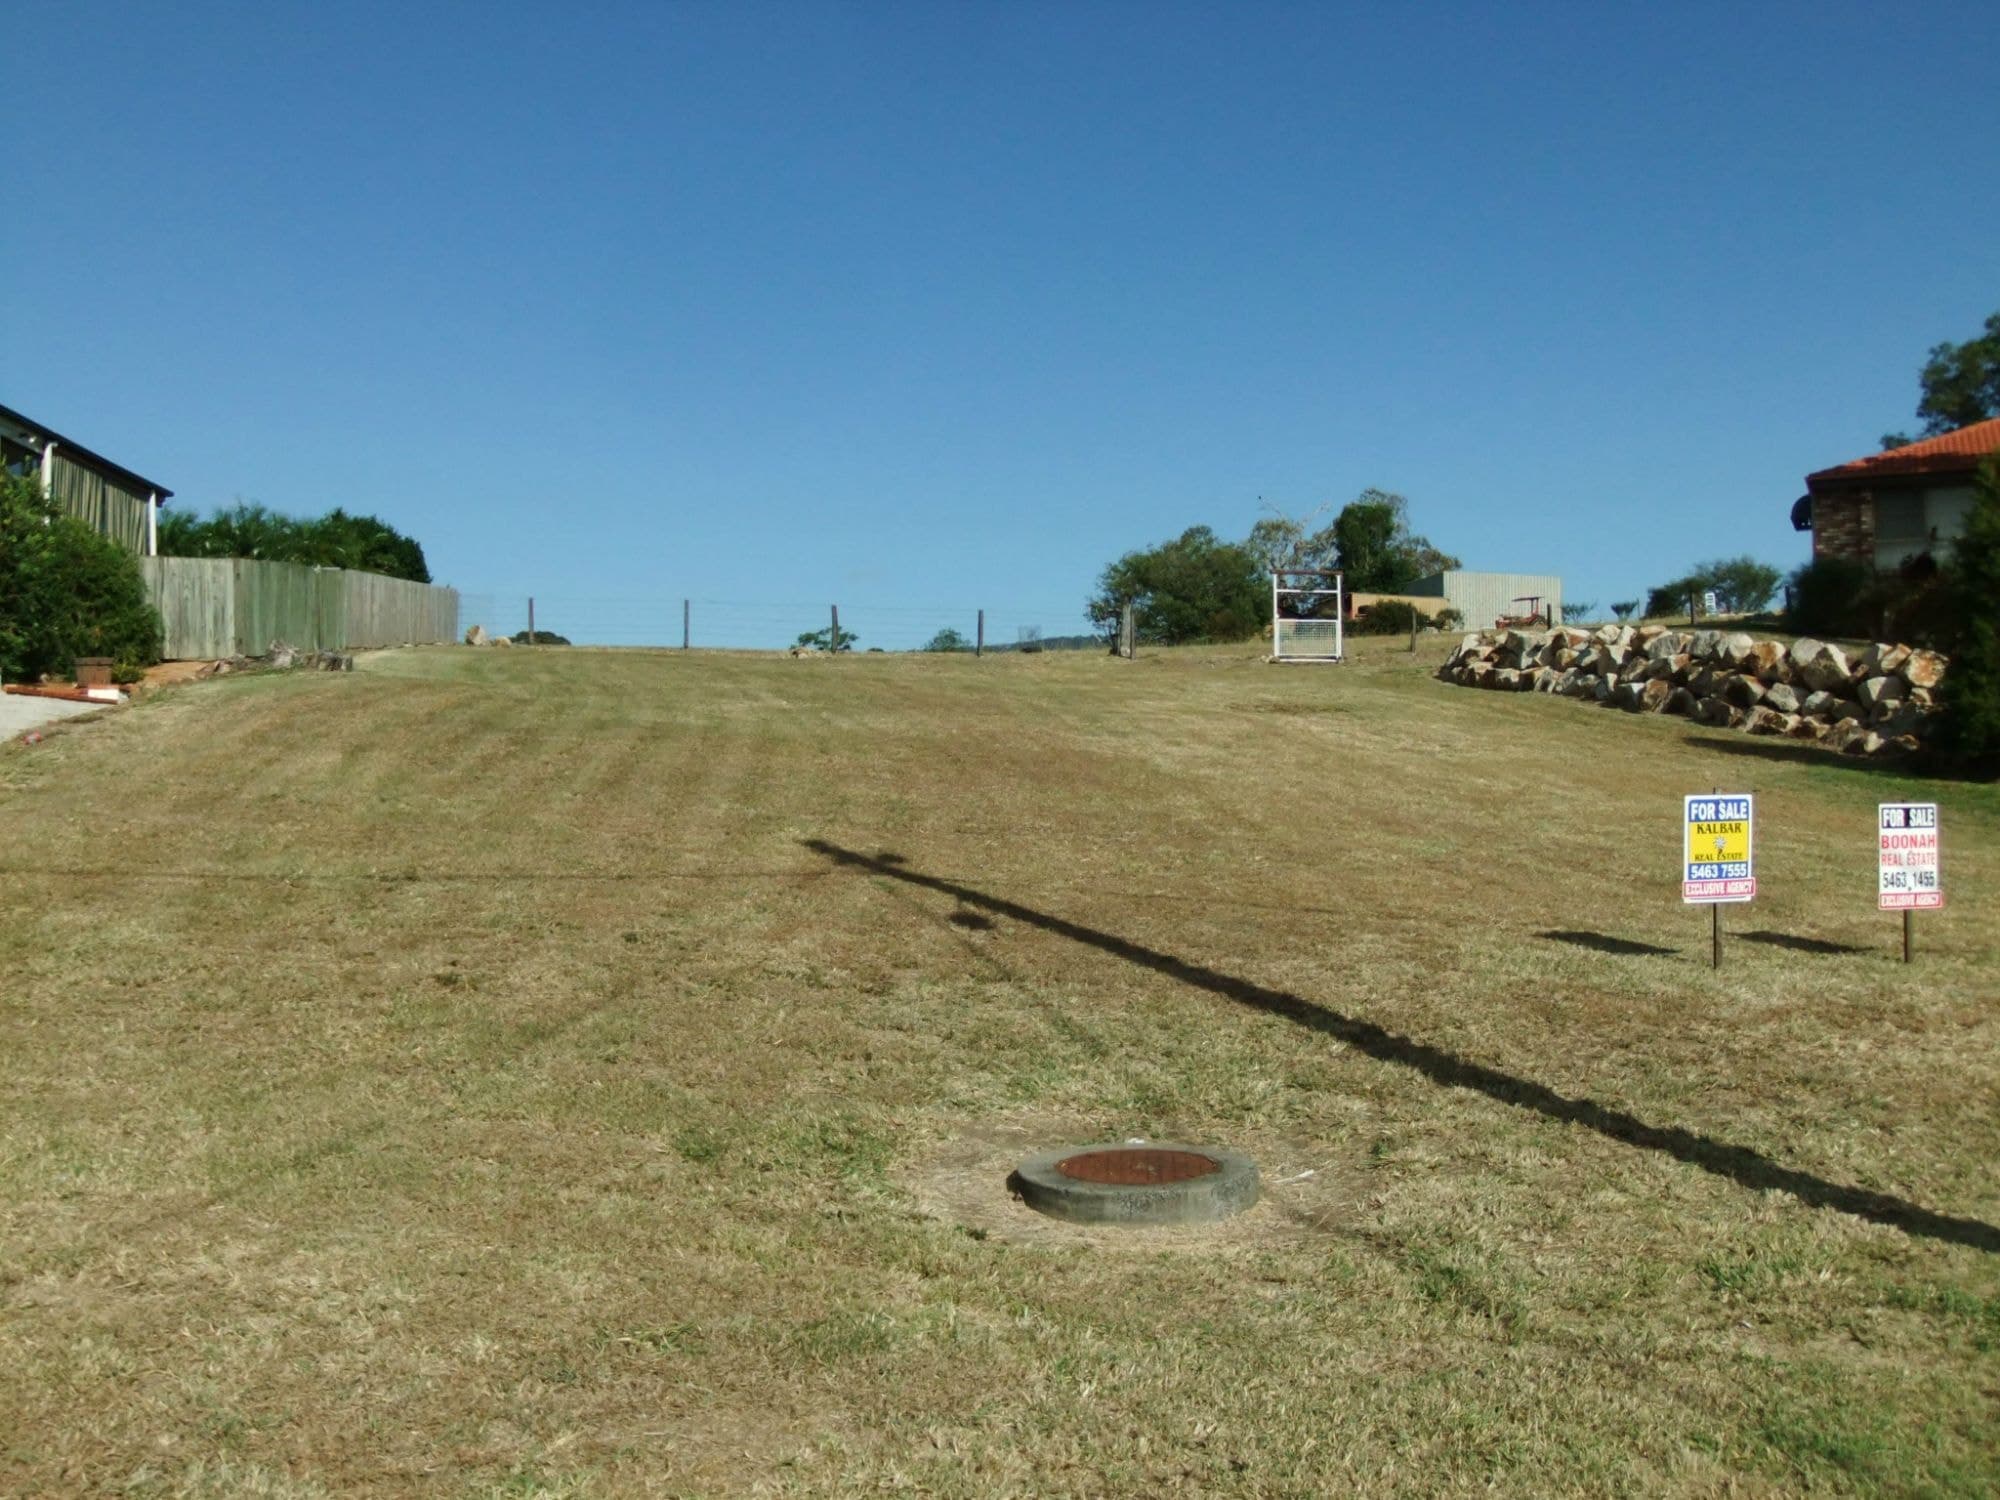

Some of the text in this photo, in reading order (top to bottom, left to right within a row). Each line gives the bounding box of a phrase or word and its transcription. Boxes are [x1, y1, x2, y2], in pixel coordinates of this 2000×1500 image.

[1691, 801, 1747, 820] FOR SALE
[1883, 808, 1934, 827] FOR SALE
[1697, 822, 1741, 834] KALBAR
[1881, 835, 1935, 849] BOONAH
[1694, 852, 1743, 862] REAL ESTATE
[1881, 851, 1936, 866] REAL ESTATE
[1691, 863, 1747, 879] 5463 7555
[1883, 872, 1907, 888] 5463
